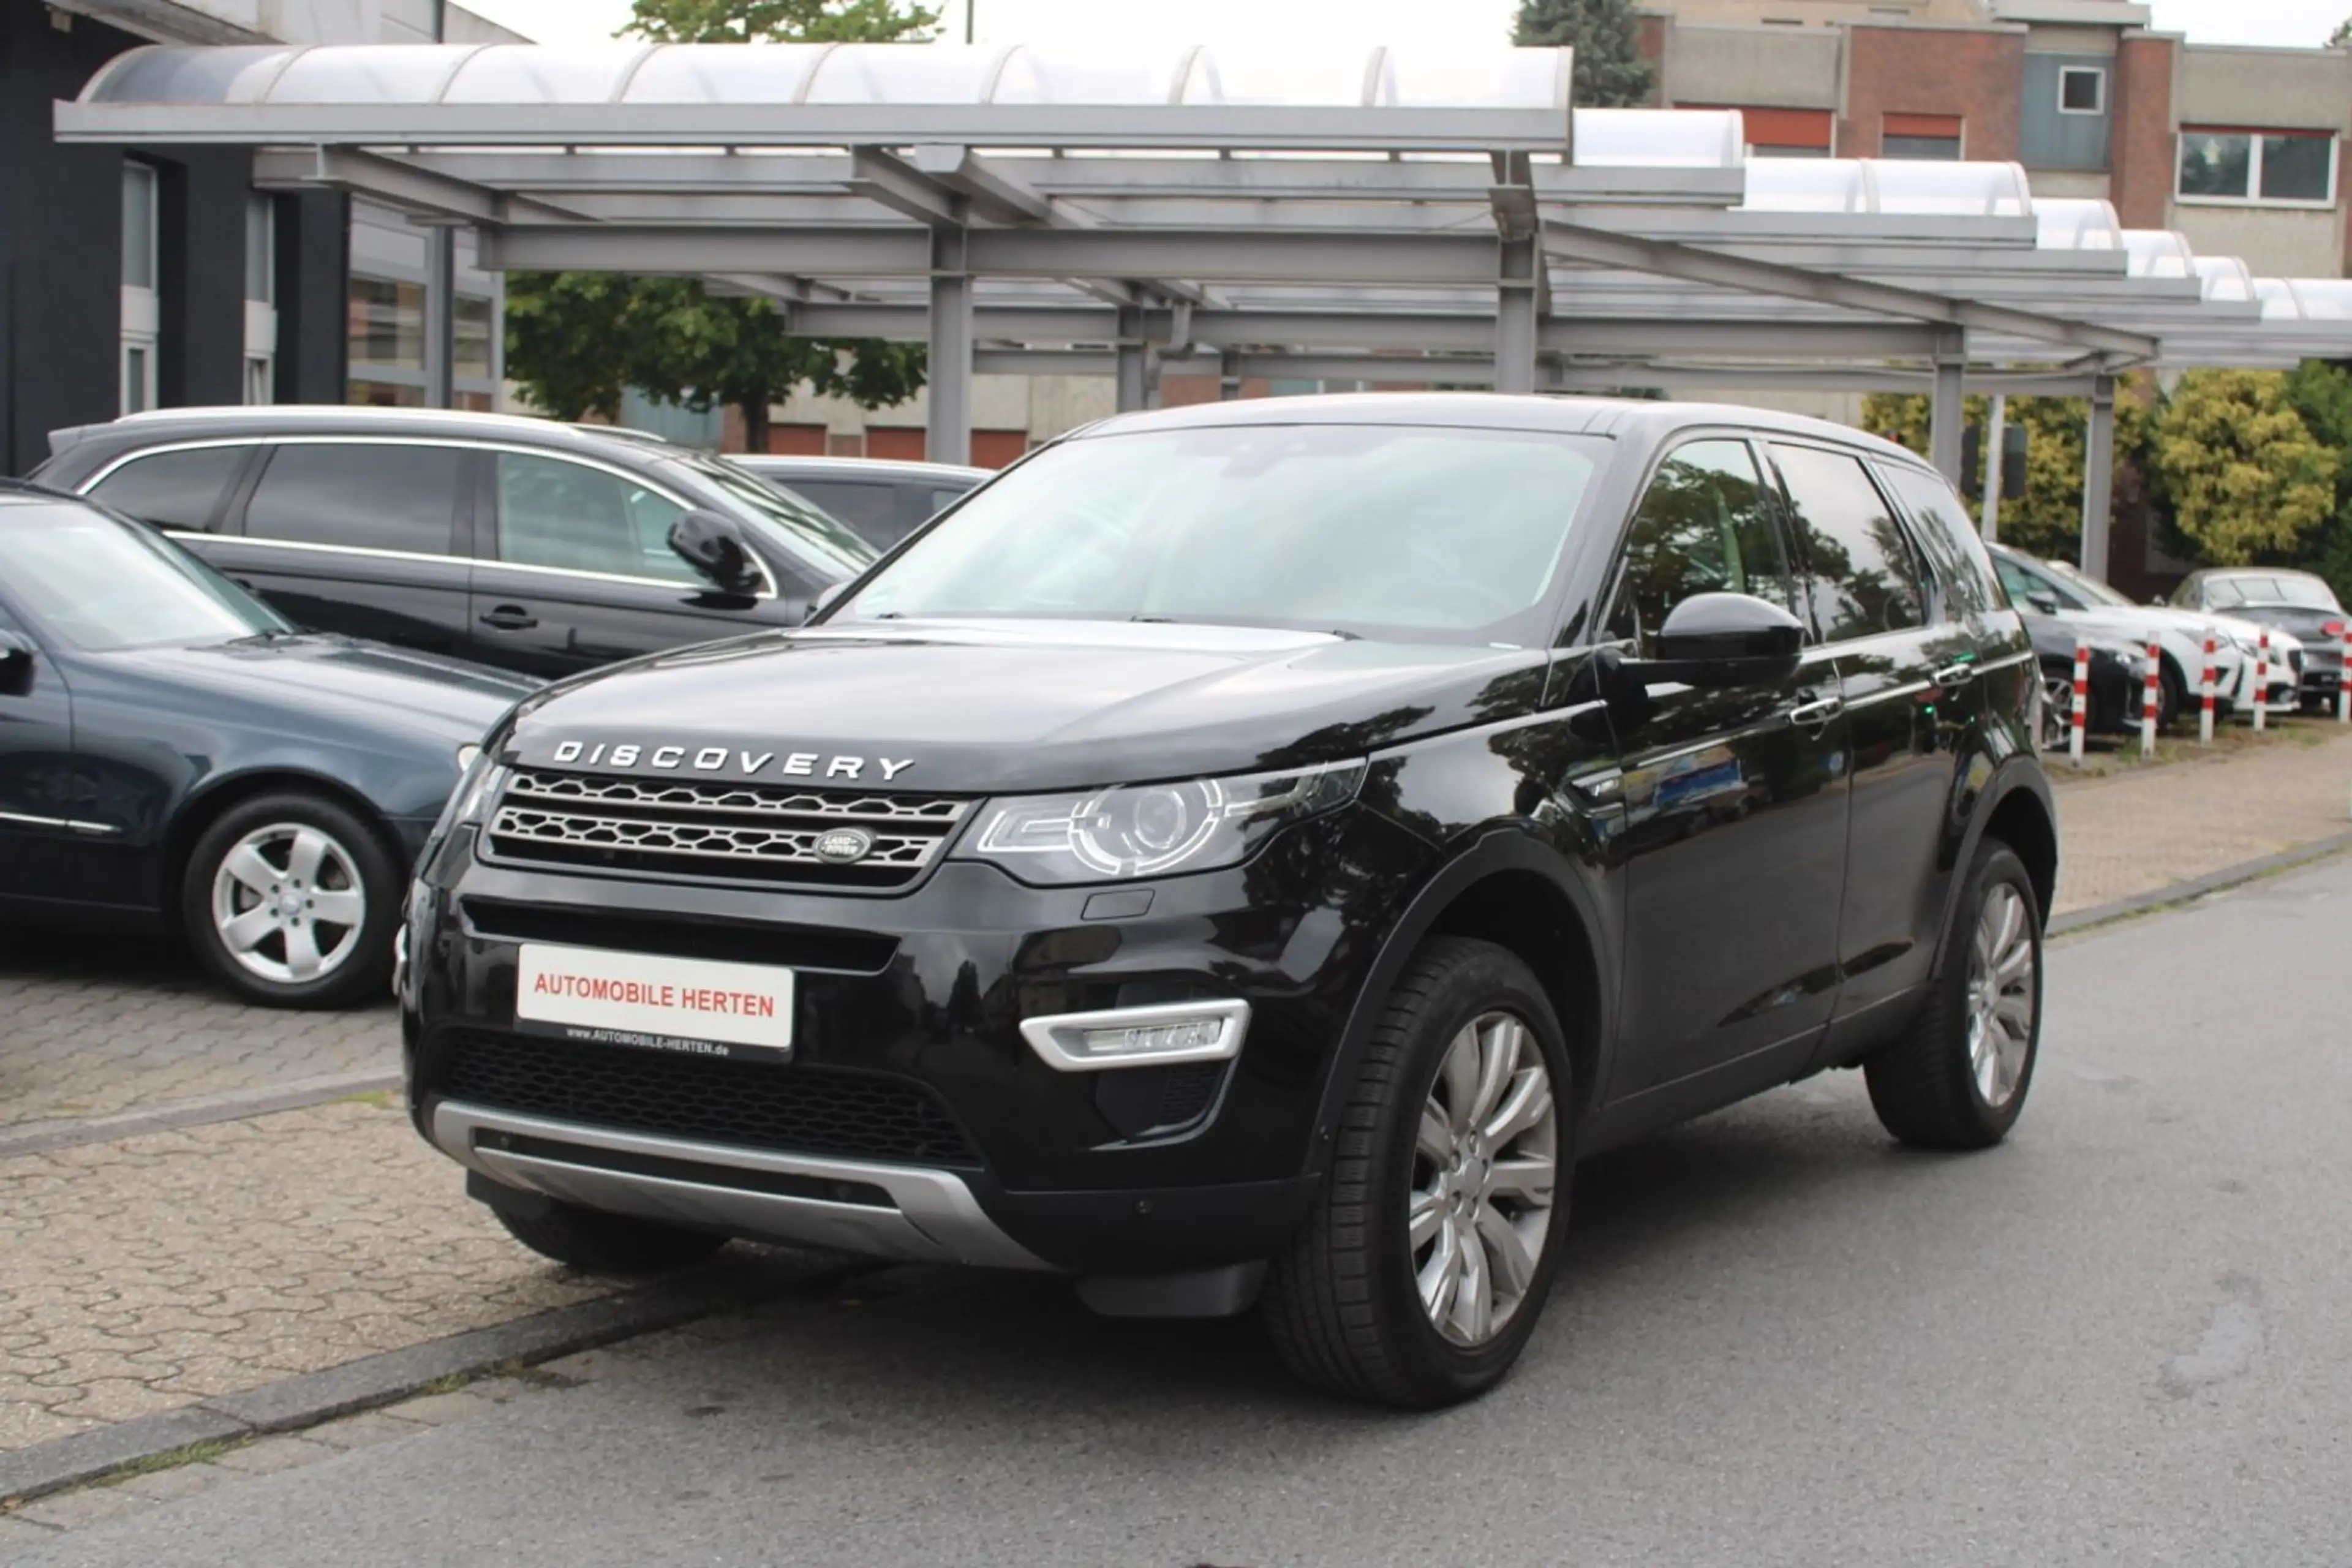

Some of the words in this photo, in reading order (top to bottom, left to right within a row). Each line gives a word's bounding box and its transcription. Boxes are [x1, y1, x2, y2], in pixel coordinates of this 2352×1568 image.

[554, 741, 914, 780] DISCOVERY
[535, 973, 674, 1006] AUTOMOBILE
[682, 988, 774, 1017] HERTEN
